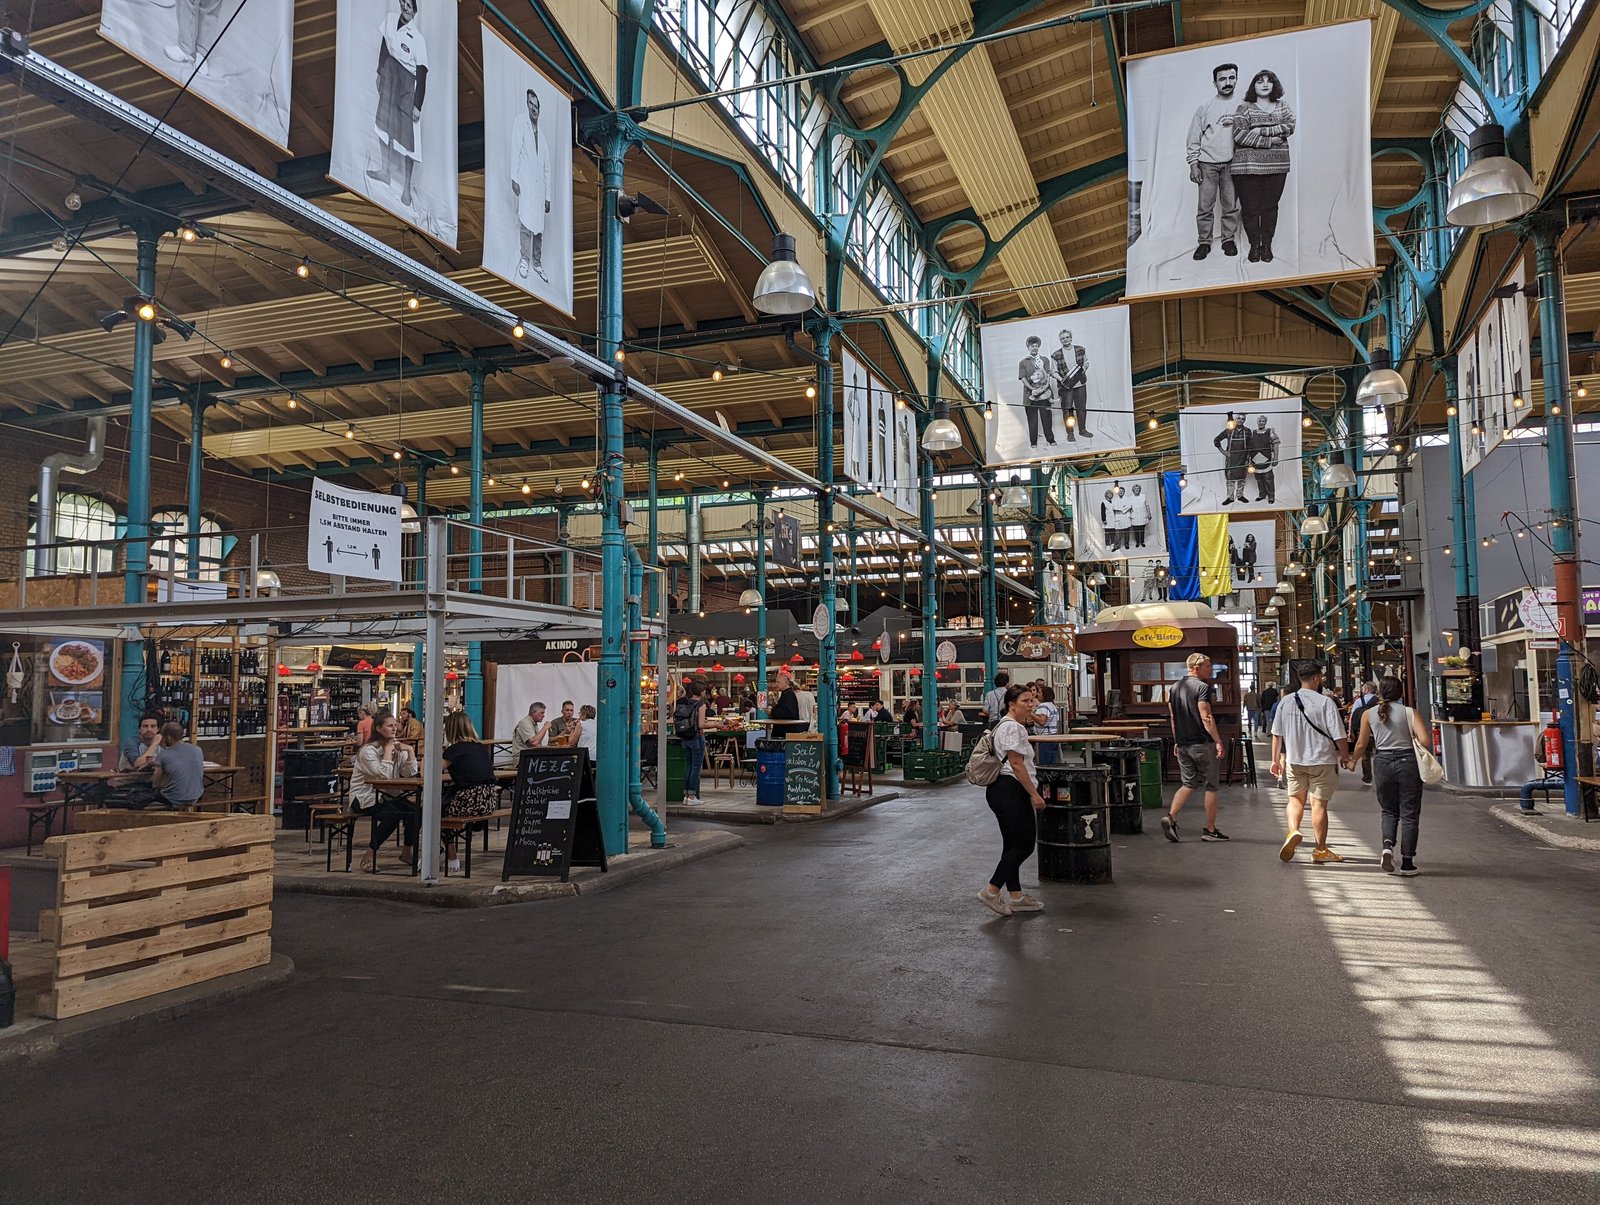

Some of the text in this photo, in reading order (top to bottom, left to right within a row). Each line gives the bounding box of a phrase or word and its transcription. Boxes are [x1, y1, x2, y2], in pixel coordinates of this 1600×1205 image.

[315, 490, 397, 515] SELBSTBEDIENUNG
[332, 514, 370, 526] BITTE IMMER
[333, 522, 360, 533] ABSTAND
[362, 527, 387, 536] HALTEN
[1134, 633, 1181, 641] Café-Bistro
[545, 641, 578, 650] AKINDO
[792, 744, 816, 756] Seit
[528, 758, 570, 773] MEZE
